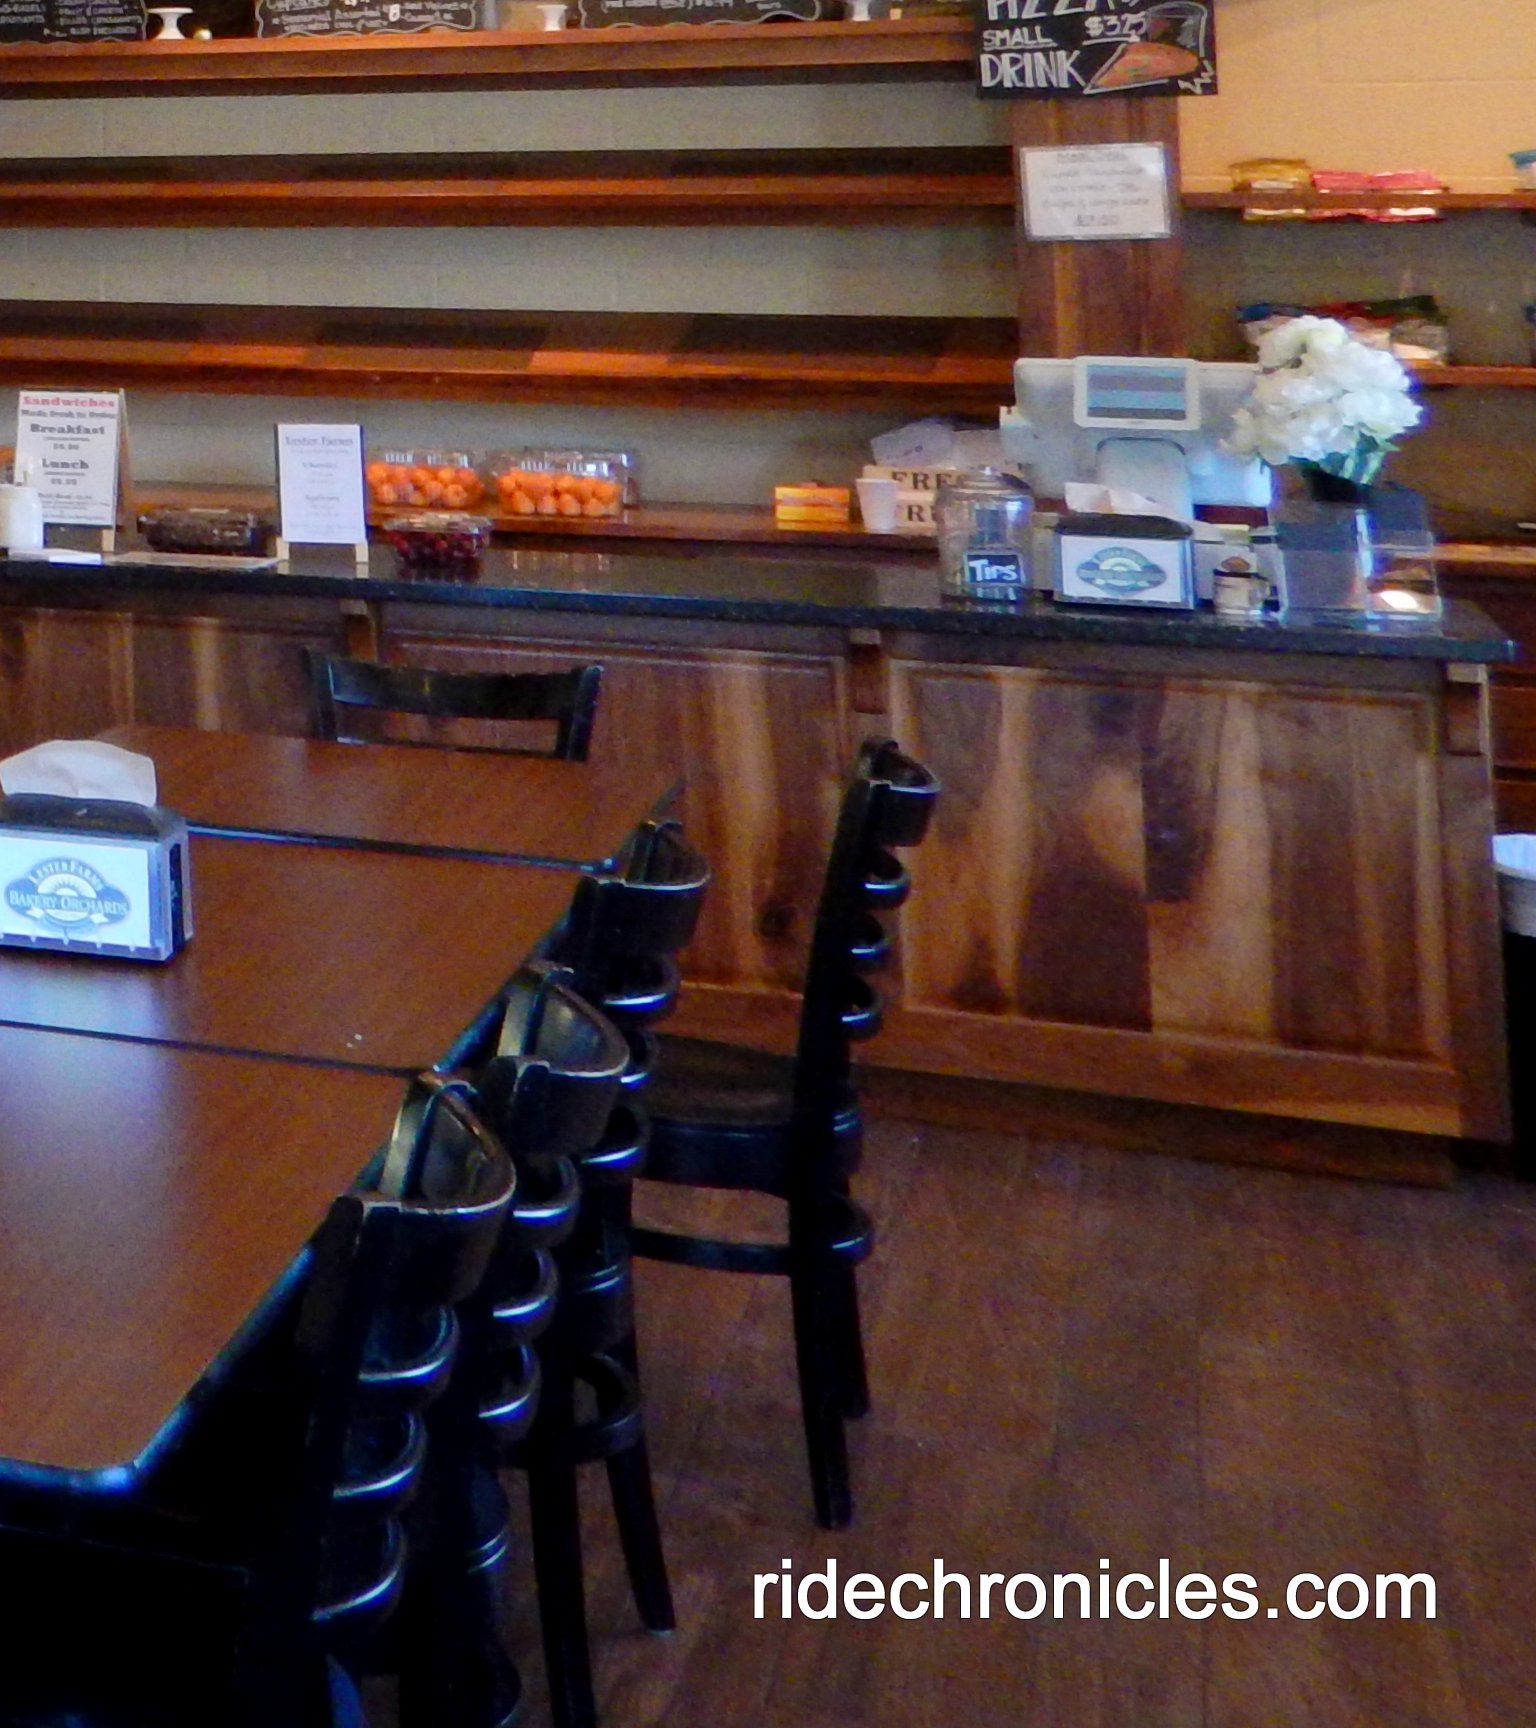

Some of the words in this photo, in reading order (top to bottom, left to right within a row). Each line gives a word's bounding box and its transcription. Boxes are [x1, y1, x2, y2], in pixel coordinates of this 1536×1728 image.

[983, 25, 1054, 47] SMALL
[980, 50, 1085, 88] DRINK
[23, 396, 116, 408] Sandwiches
[30, 423, 106, 435] Breakfast
[41, 457, 90, 470] Lunch
[9, 889, 58, 909] BAKERY
[60, 894, 130, 916] ORCHARDS
